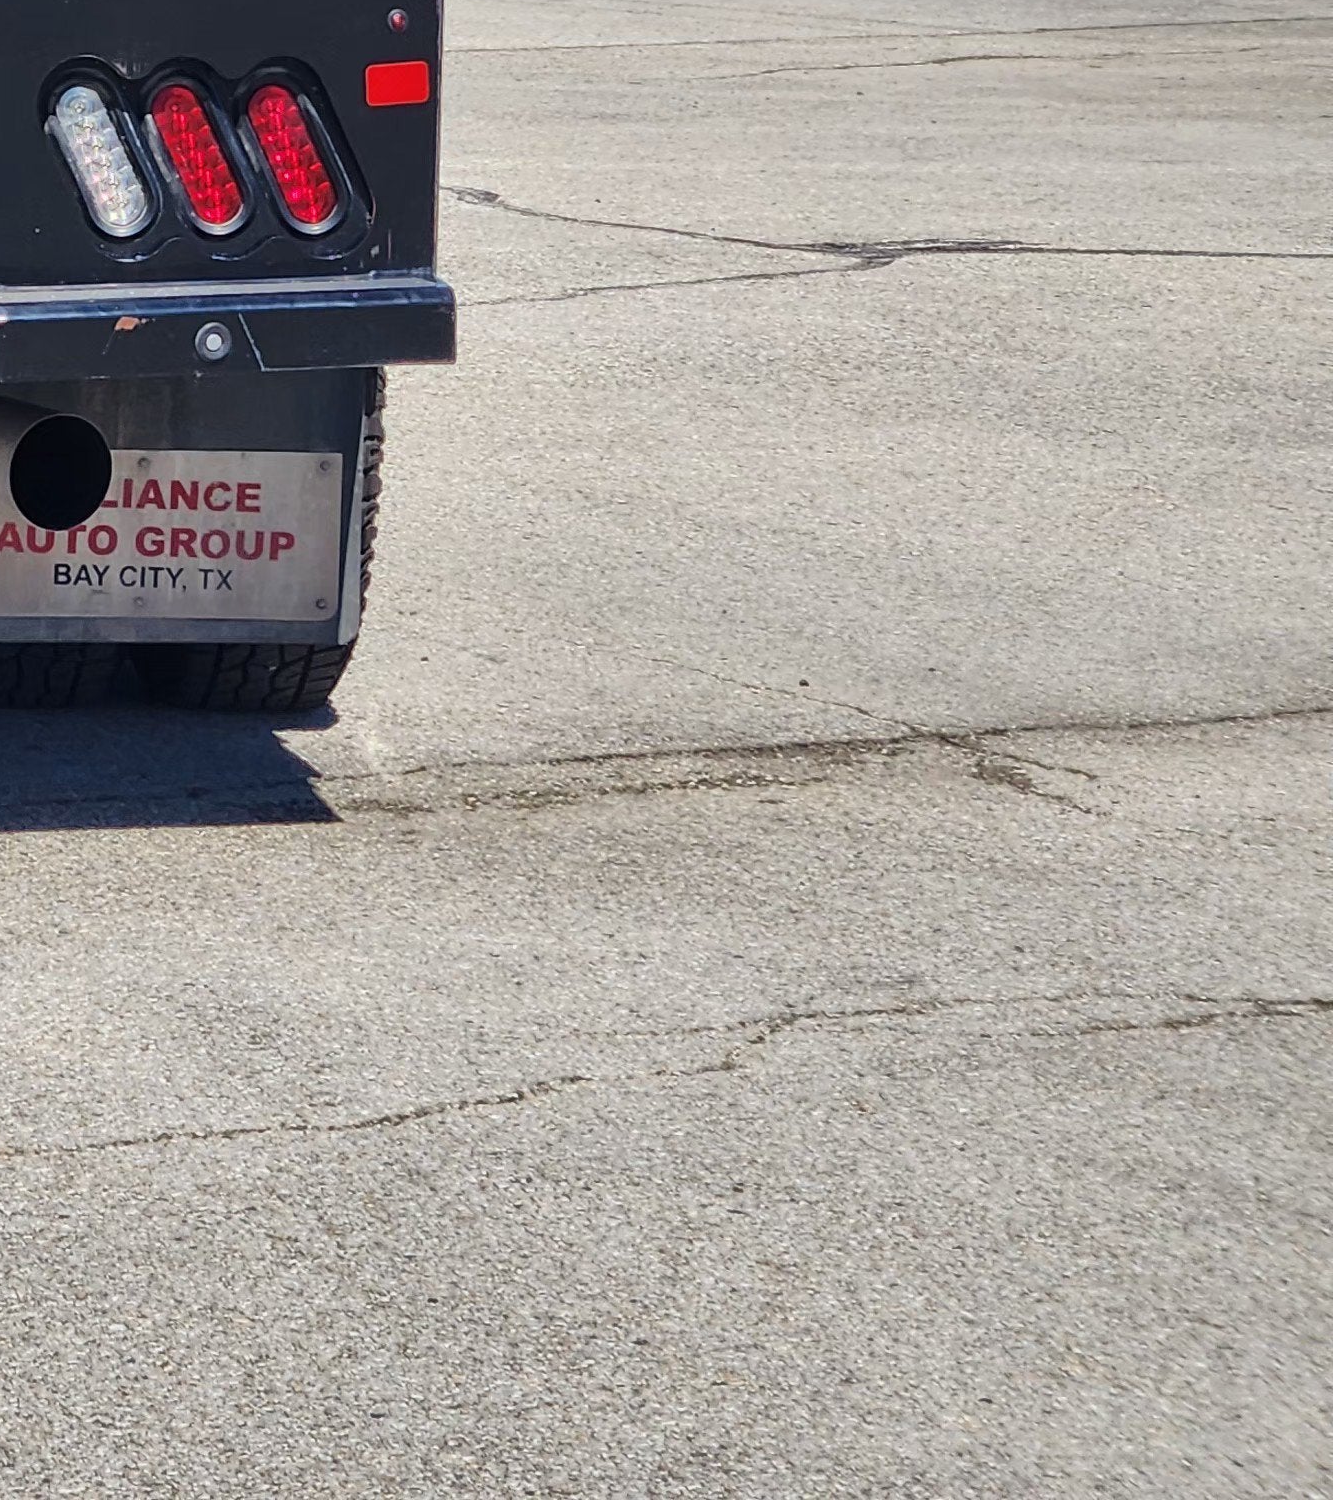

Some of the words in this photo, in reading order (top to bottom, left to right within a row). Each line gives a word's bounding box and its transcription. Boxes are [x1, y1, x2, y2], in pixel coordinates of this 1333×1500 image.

[99, 478, 262, 513] IANCE
[135, 526, 296, 561] GROUP
[53, 563, 110, 587] BAY
[119, 565, 187, 593] CITY,
[198, 568, 233, 591] TX
